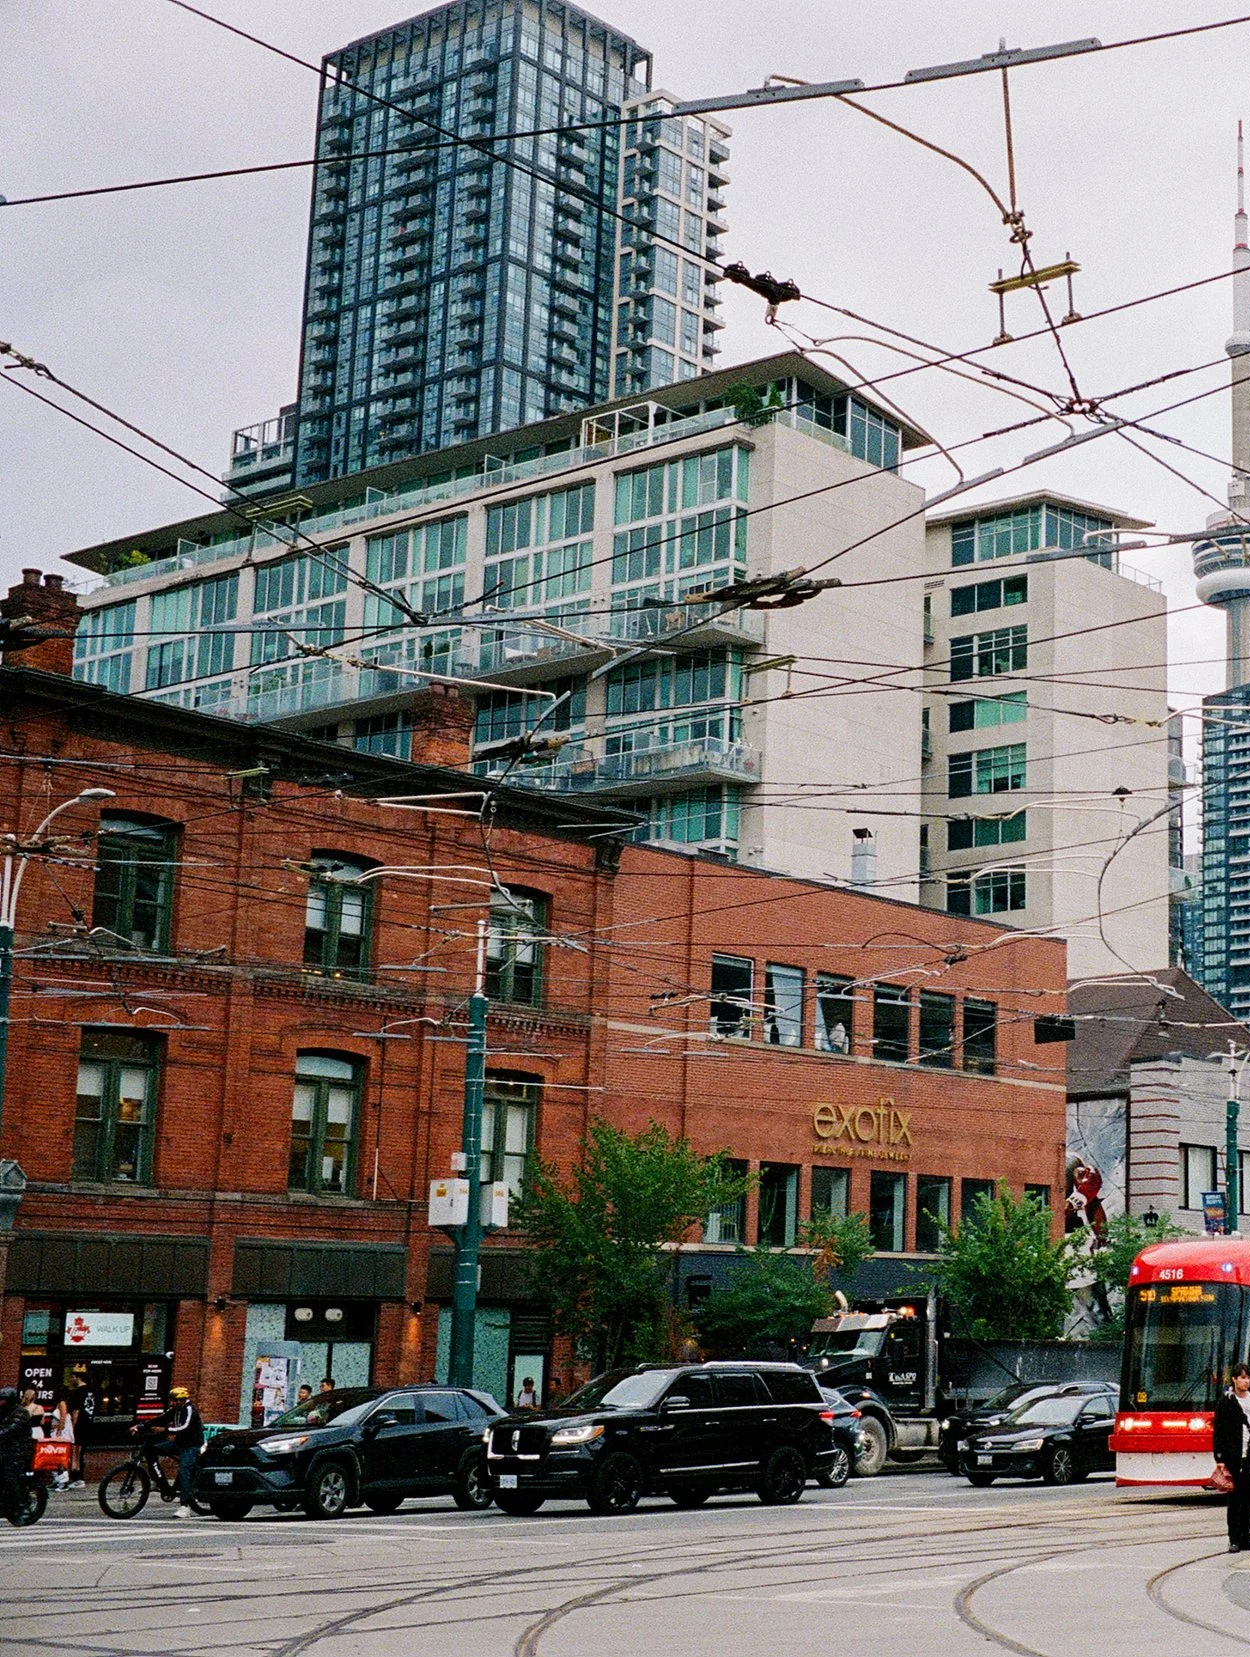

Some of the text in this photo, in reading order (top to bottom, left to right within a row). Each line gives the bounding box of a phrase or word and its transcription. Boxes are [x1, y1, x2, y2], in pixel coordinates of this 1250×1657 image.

[1159, 1268, 1184, 1280] 4516
[97, 1325, 120, 1334] WALK
[24, 1368, 52, 1377] OPEN
